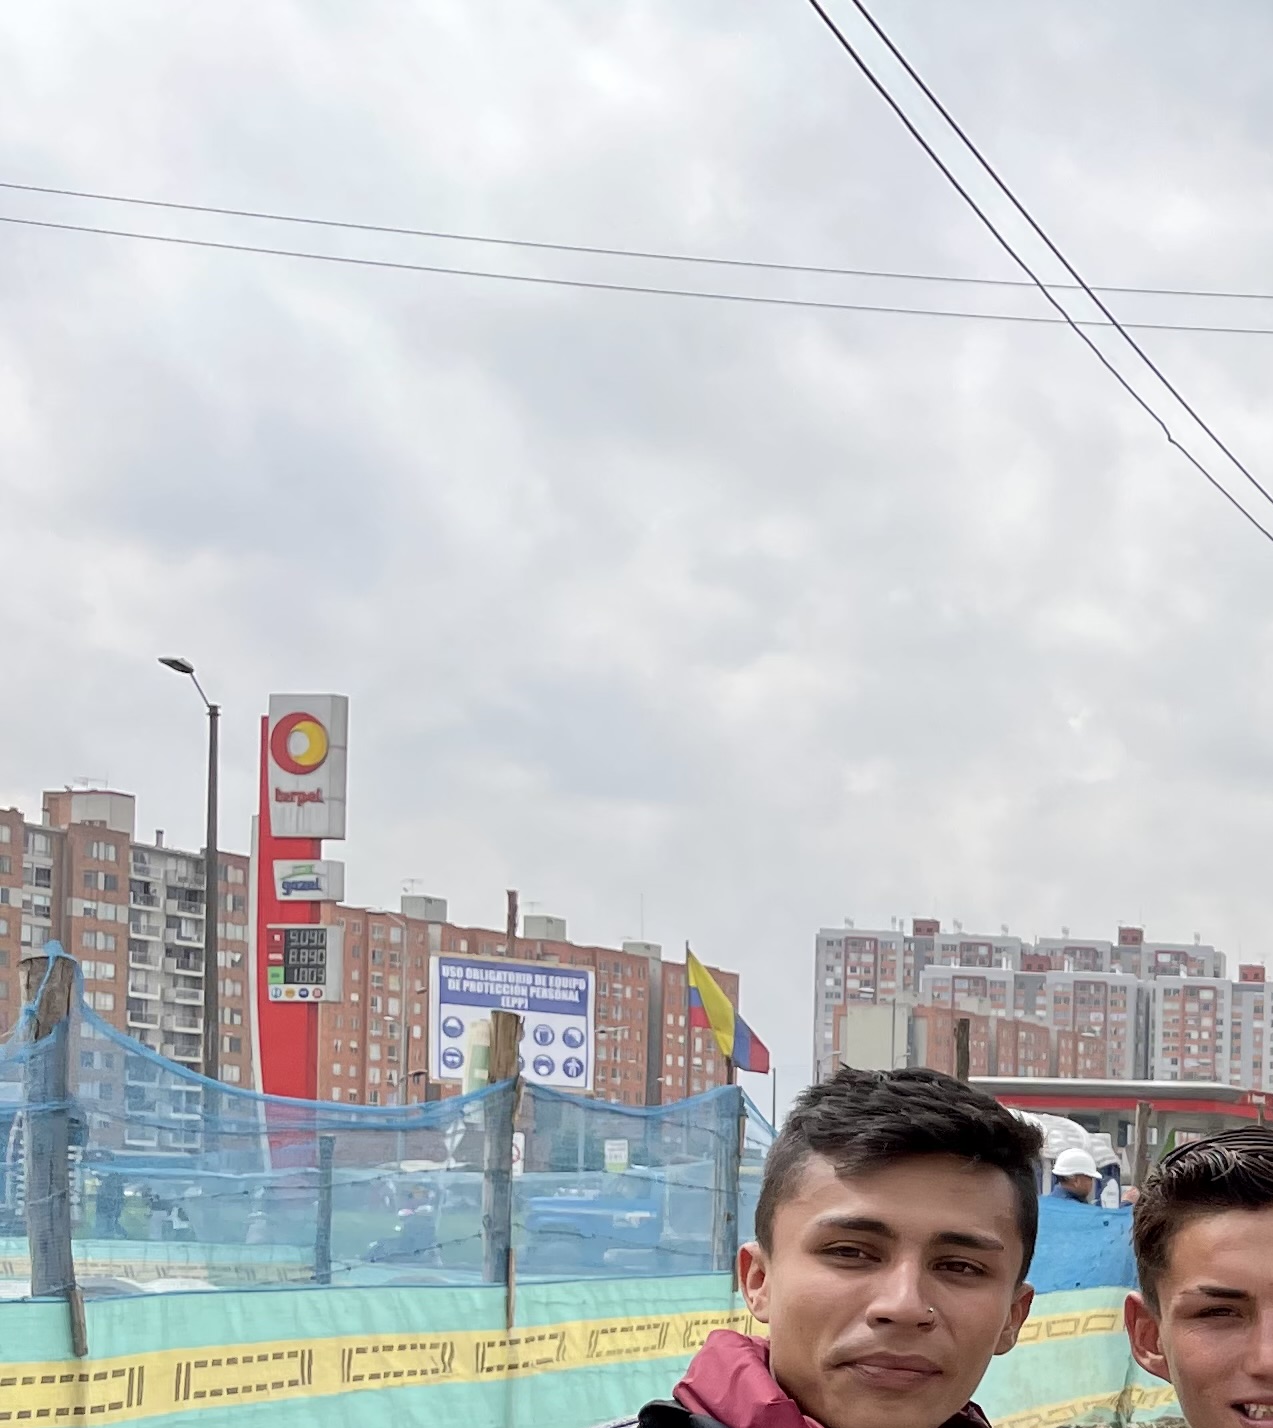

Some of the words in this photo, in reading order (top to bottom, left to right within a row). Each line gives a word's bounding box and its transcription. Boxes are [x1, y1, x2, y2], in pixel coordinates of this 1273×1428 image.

[441, 965, 464, 978] USO
[465, 967, 533, 985] OBLIGATORIO
[534, 974, 547, 986] DE
[549, 975, 586, 990] EQUIPO
[448, 978, 461, 990] DE
[529, 987, 580, 1002] PERSONAL
